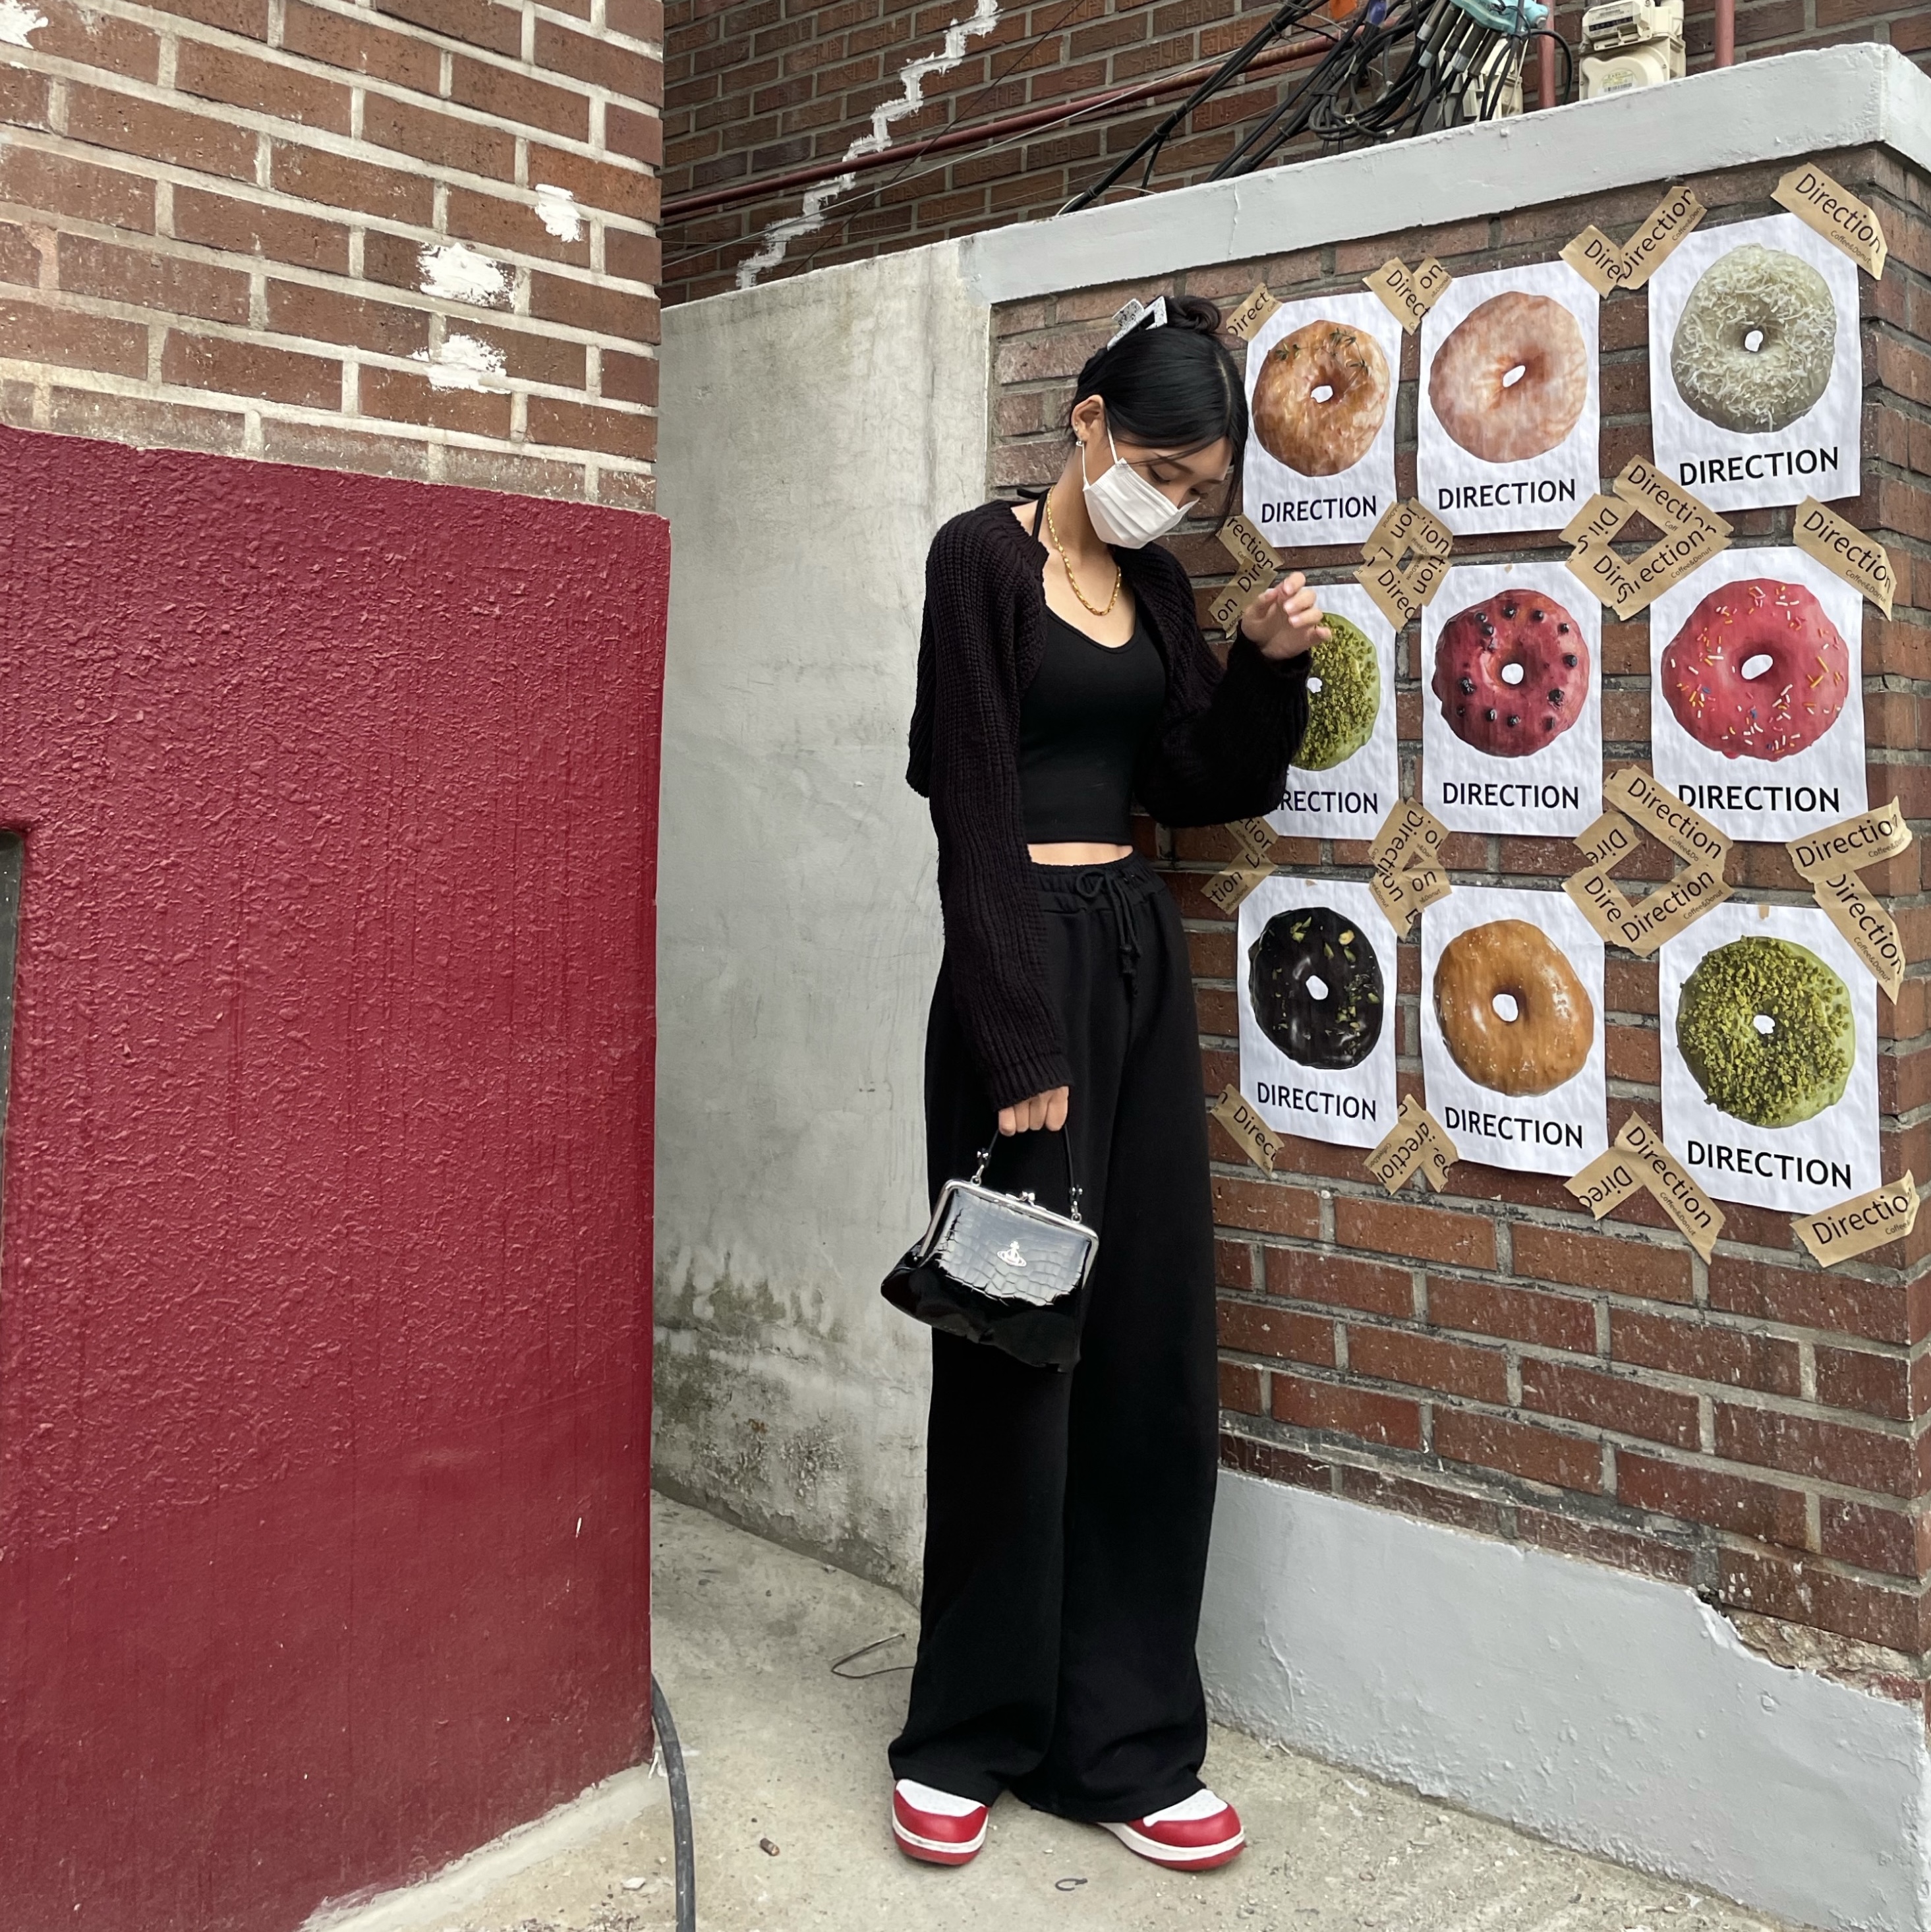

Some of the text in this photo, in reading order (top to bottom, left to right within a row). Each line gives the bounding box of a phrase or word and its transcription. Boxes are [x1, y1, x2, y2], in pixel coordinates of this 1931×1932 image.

[1795, 173, 1881, 254] Direction
[1679, 446, 1839, 486] DIRECTION
[1261, 495, 1377, 523] DIRECTION
[1439, 479, 1575, 510] DIRECTION
[1277, 790, 1378, 815] RECTION
[1443, 782, 1578, 809] DIRECTION
[1679, 784, 1839, 813] DIRECTION
[1627, 776, 1722, 860] Direction
[1620, 871, 1715, 943] Direction
[1257, 1082, 1376, 1122] DIRECTION
[1445, 1106, 1583, 1149] DIRECTION
[1625, 1125, 1712, 1229] Direction
[1688, 1140, 1852, 1190] DIRECTION
[1812, 1187, 1912, 1245] Directio
